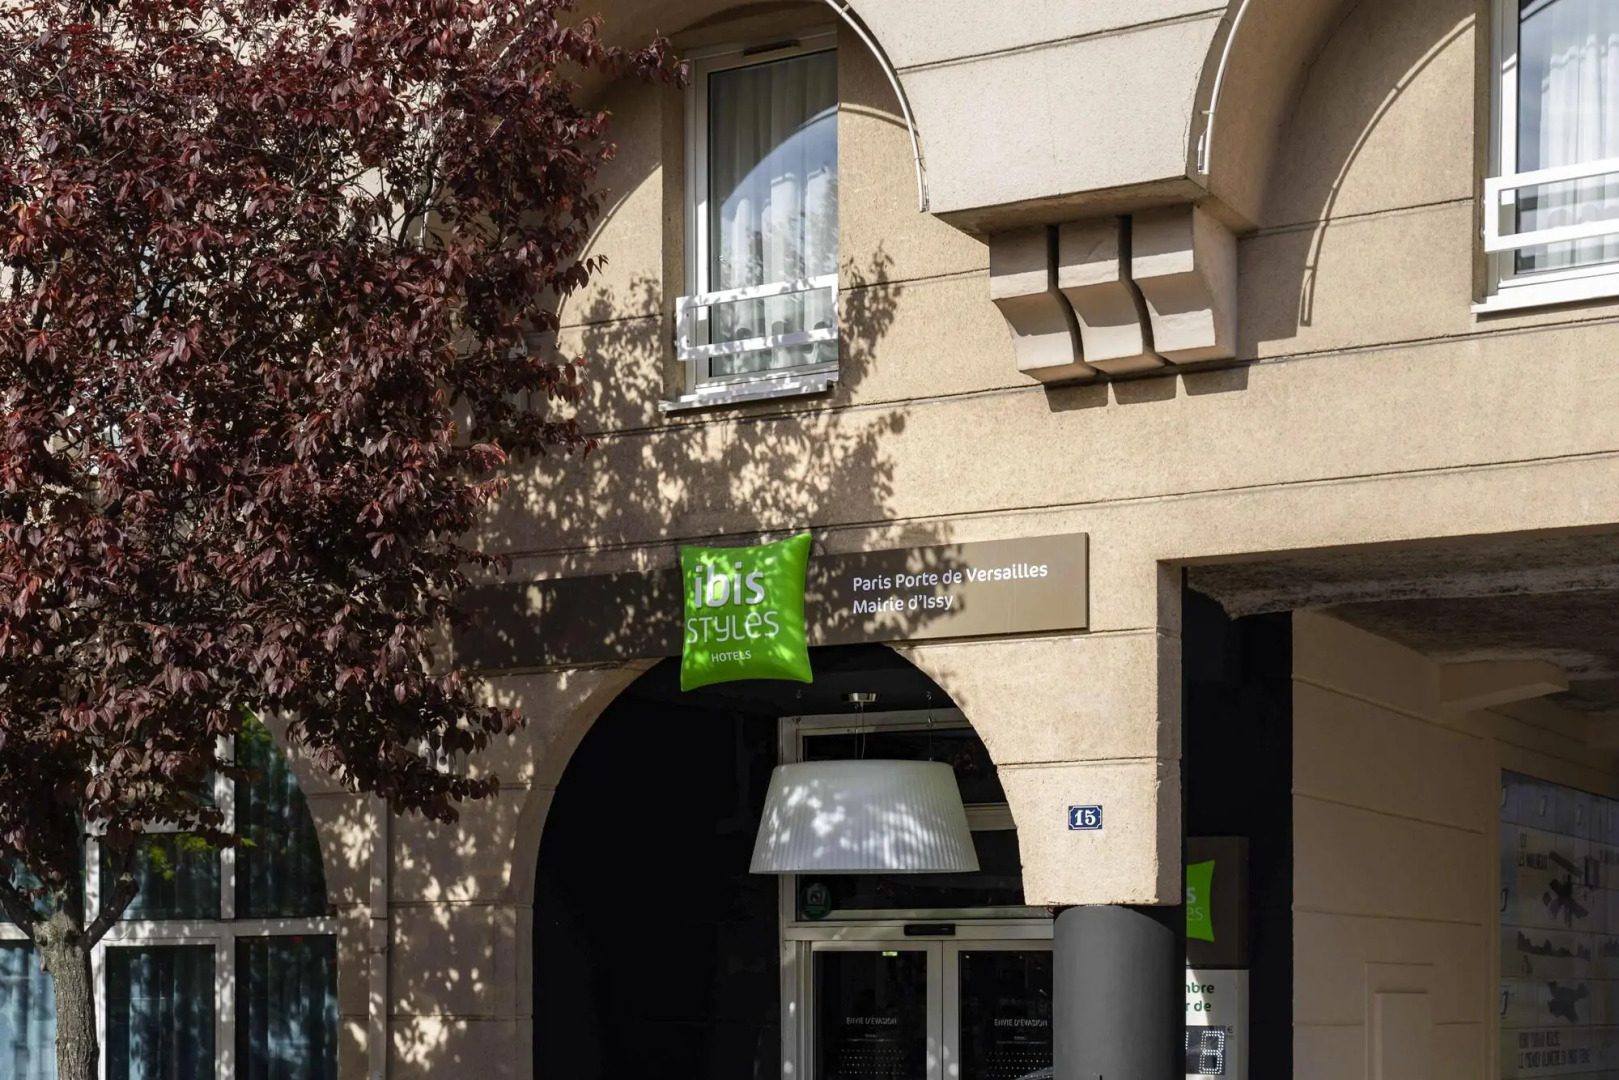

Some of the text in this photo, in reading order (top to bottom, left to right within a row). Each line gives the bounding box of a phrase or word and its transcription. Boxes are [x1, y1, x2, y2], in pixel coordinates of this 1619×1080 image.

[695, 562, 765, 609] ibis
[853, 563, 1048, 591] Paris Porte de Versailles
[853, 597, 904, 614] Mairie
[711, 650, 751, 662] HOTELS
[1074, 809, 1096, 826] 15
[1194, 1000, 1211, 1012] de
